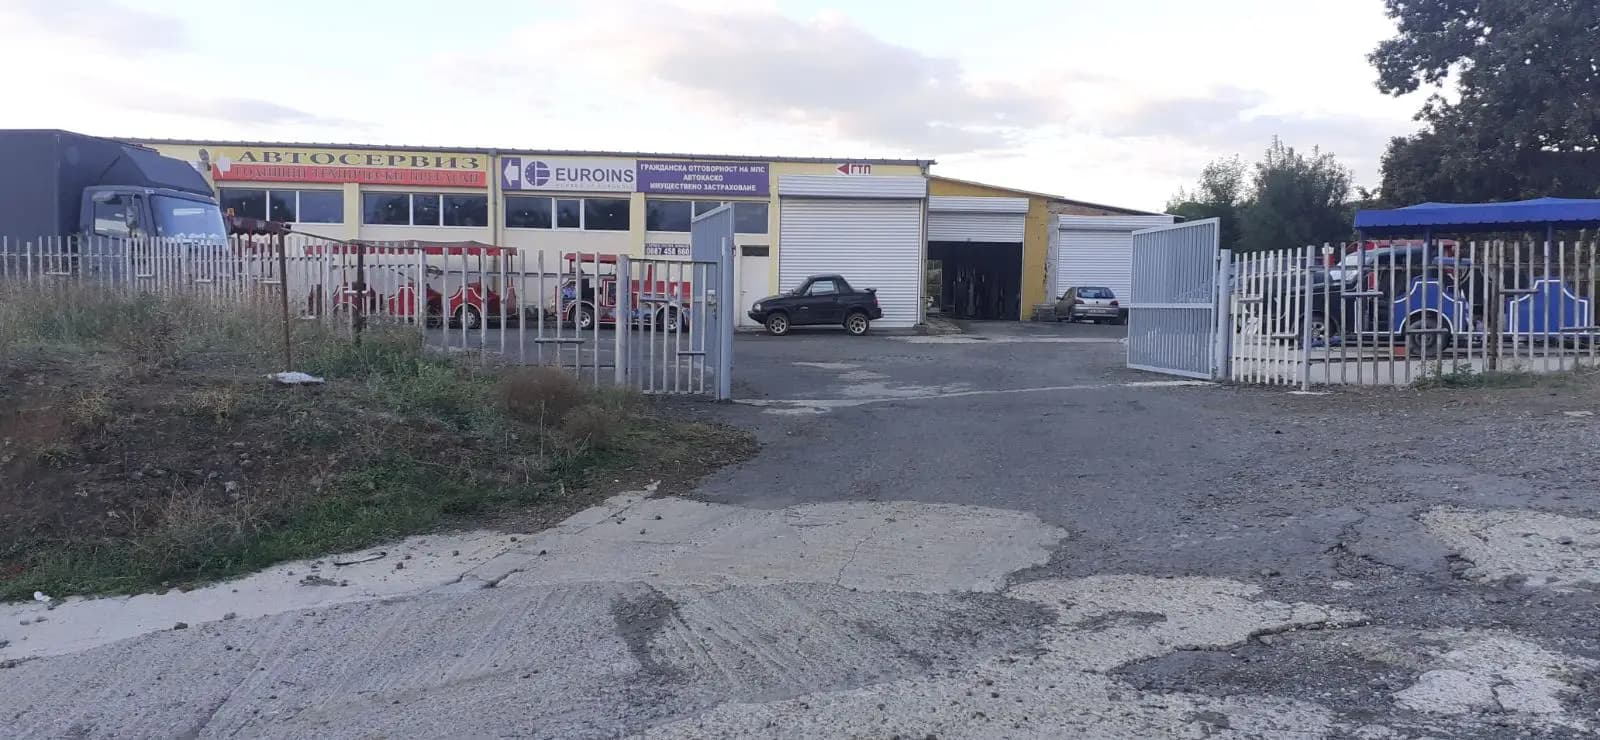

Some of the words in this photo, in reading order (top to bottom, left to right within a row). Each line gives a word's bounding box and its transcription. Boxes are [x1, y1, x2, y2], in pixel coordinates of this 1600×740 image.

[239, 151, 479, 169] АВТОСЕРВИЗ
[640, 163, 687, 172] ГРАЖДАНСКА
[688, 164, 738, 173] ОТГОВОРНОСТ
[739, 165, 749, 173] НА
[850, 164, 871, 174] ГТП
[555, 167, 634, 183] EUROINS
[704, 183, 757, 191] ЗАСТРАХОВАНЕ
